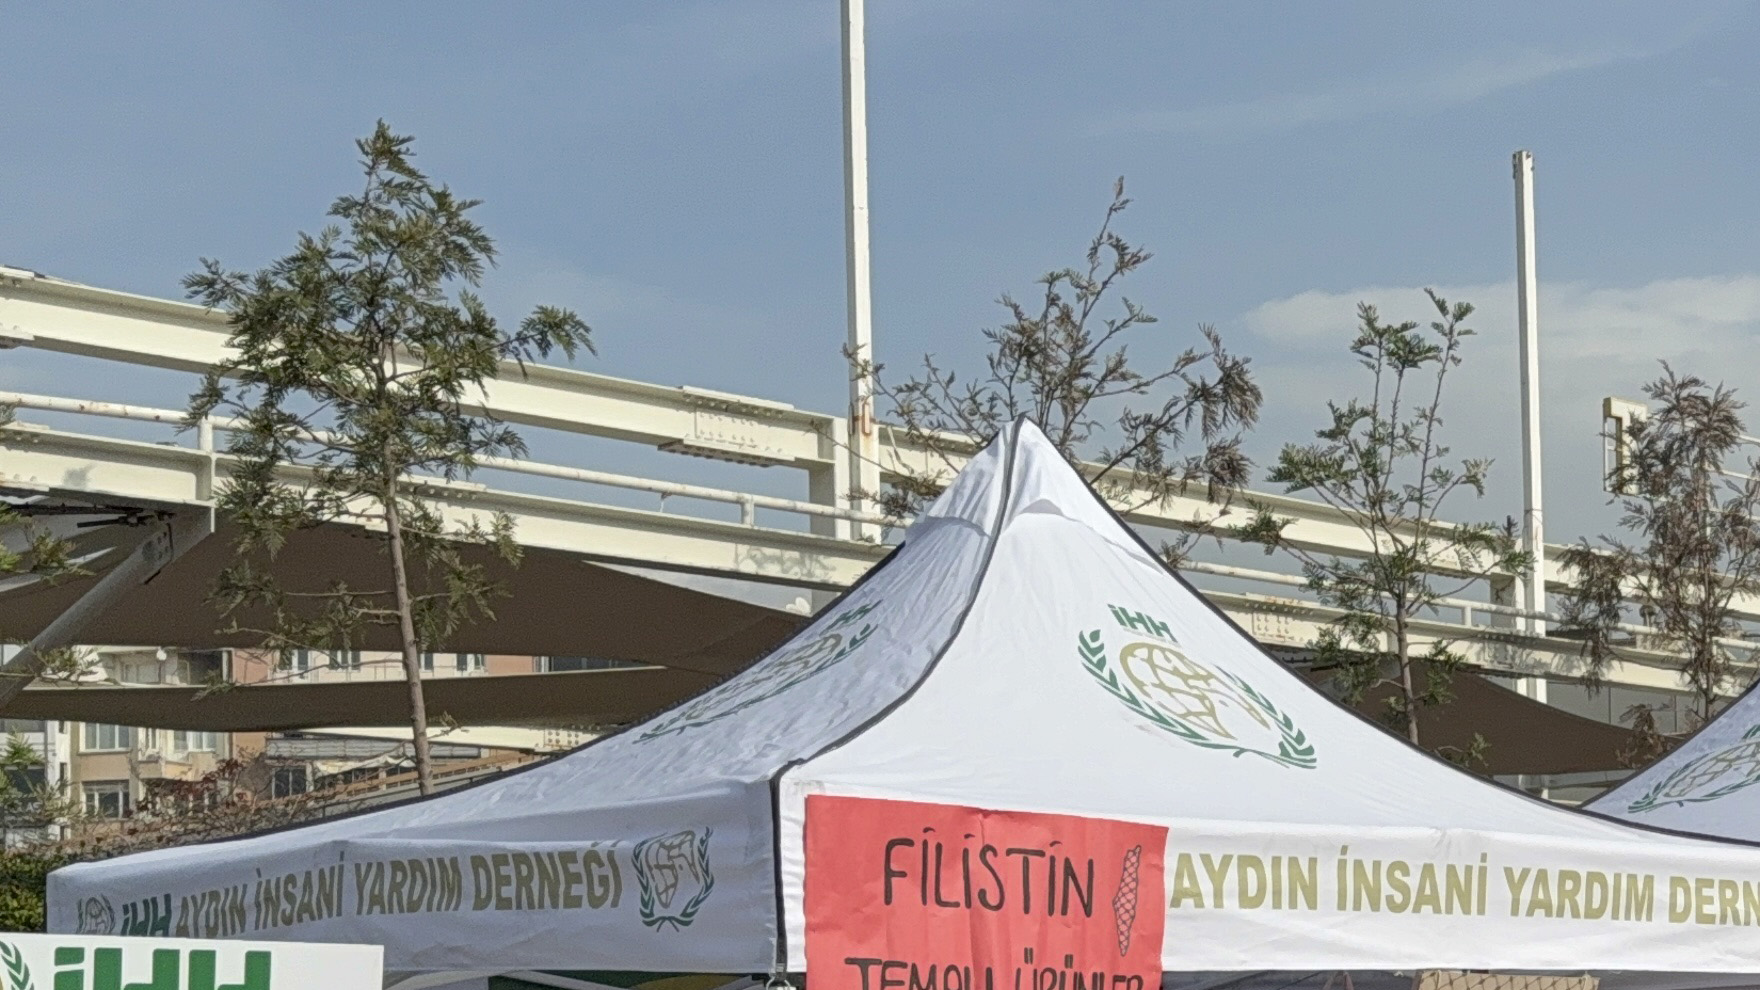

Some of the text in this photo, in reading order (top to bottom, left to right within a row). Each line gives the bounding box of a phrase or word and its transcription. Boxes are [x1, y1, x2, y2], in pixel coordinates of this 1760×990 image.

[175, 884, 249, 937] AYDIN
[254, 851, 345, 931] İNSANİ
[354, 857, 463, 915] YARDIM
[470, 839, 623, 911] DERNEĞİ
[884, 827, 1094, 918] FİLİSTİN
[1169, 852, 1318, 912] AYDIN
[1336, 845, 1488, 917] İNSANİ
[1503, 866, 1656, 923] YARDIM
